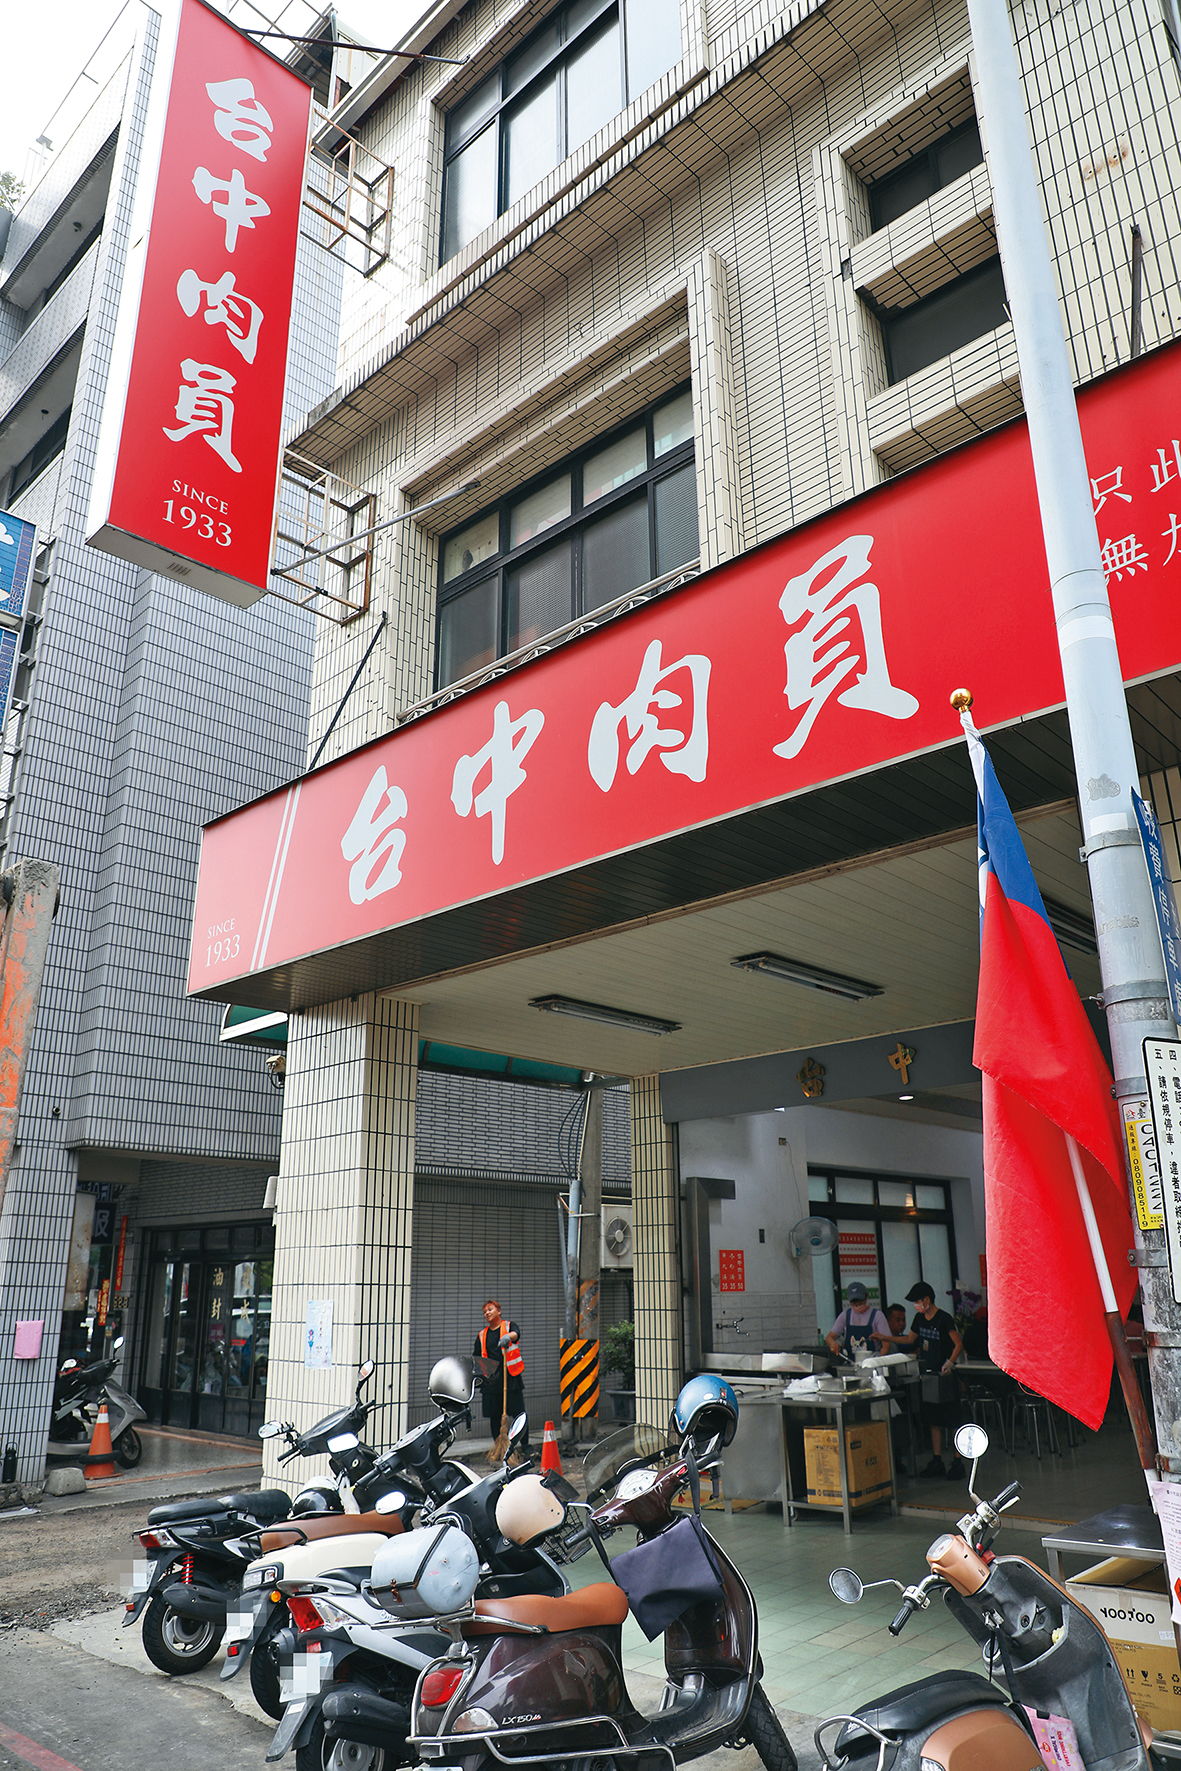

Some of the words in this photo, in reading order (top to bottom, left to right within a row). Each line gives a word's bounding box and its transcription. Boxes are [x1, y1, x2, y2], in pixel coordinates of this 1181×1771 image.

[162, 78, 273, 472] 台中肉員
[172, 479, 228, 515] SINCE
[162, 499, 233, 547] 1933
[341, 535, 919, 905] 台中肉員
[205, 934, 240, 968] 1933
[207, 917, 235, 939] SINCE
[796, 1043, 915, 1097] 台中
